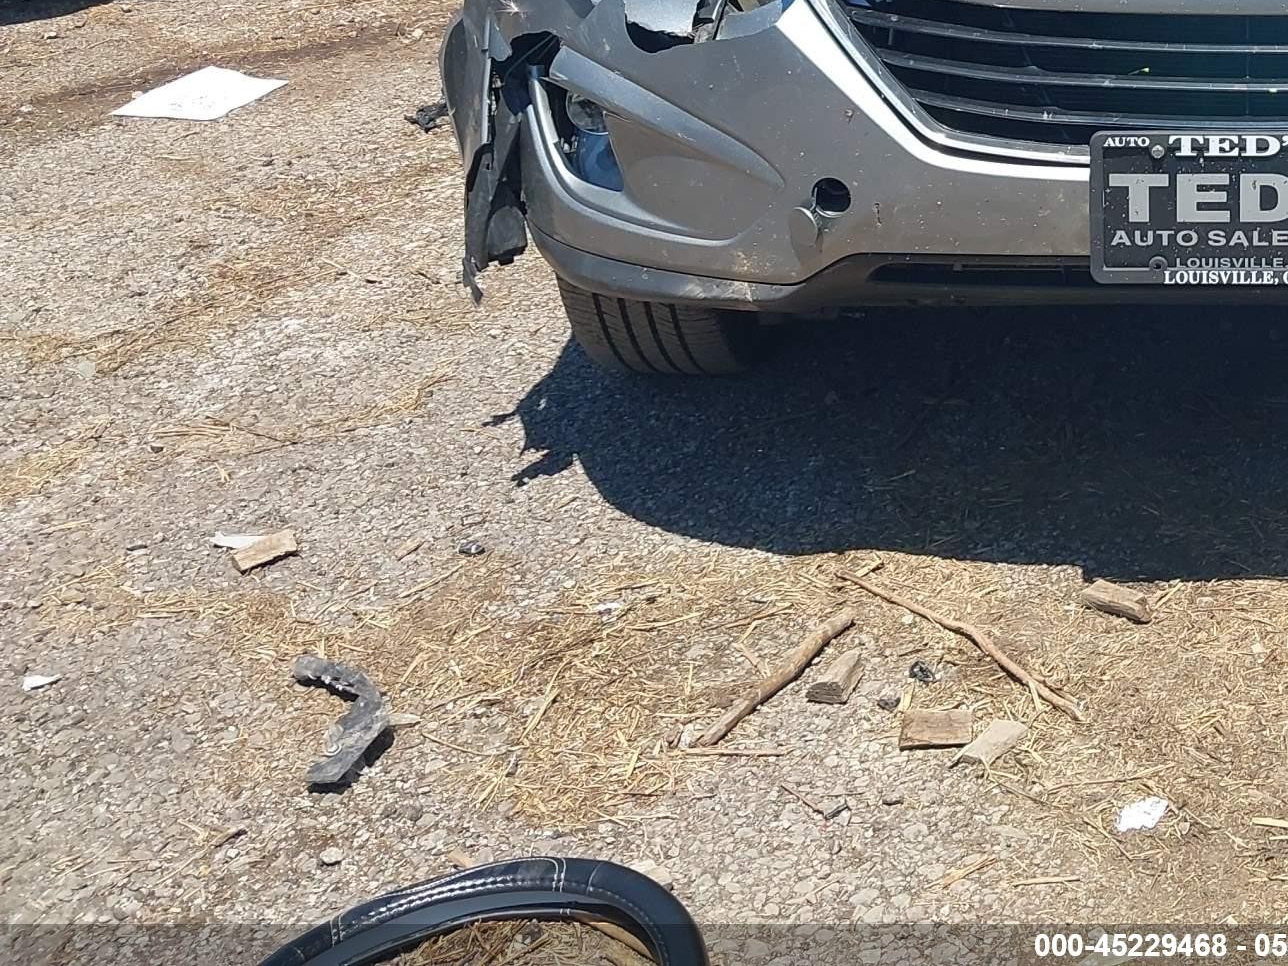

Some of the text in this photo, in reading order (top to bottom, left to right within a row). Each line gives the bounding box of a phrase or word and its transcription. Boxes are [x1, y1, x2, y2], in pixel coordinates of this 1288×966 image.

[1103, 136, 1150, 147] AUTO
[1110, 229, 1198, 247] AUTO
[1163, 270, 1279, 286] LOUISVILLE,
